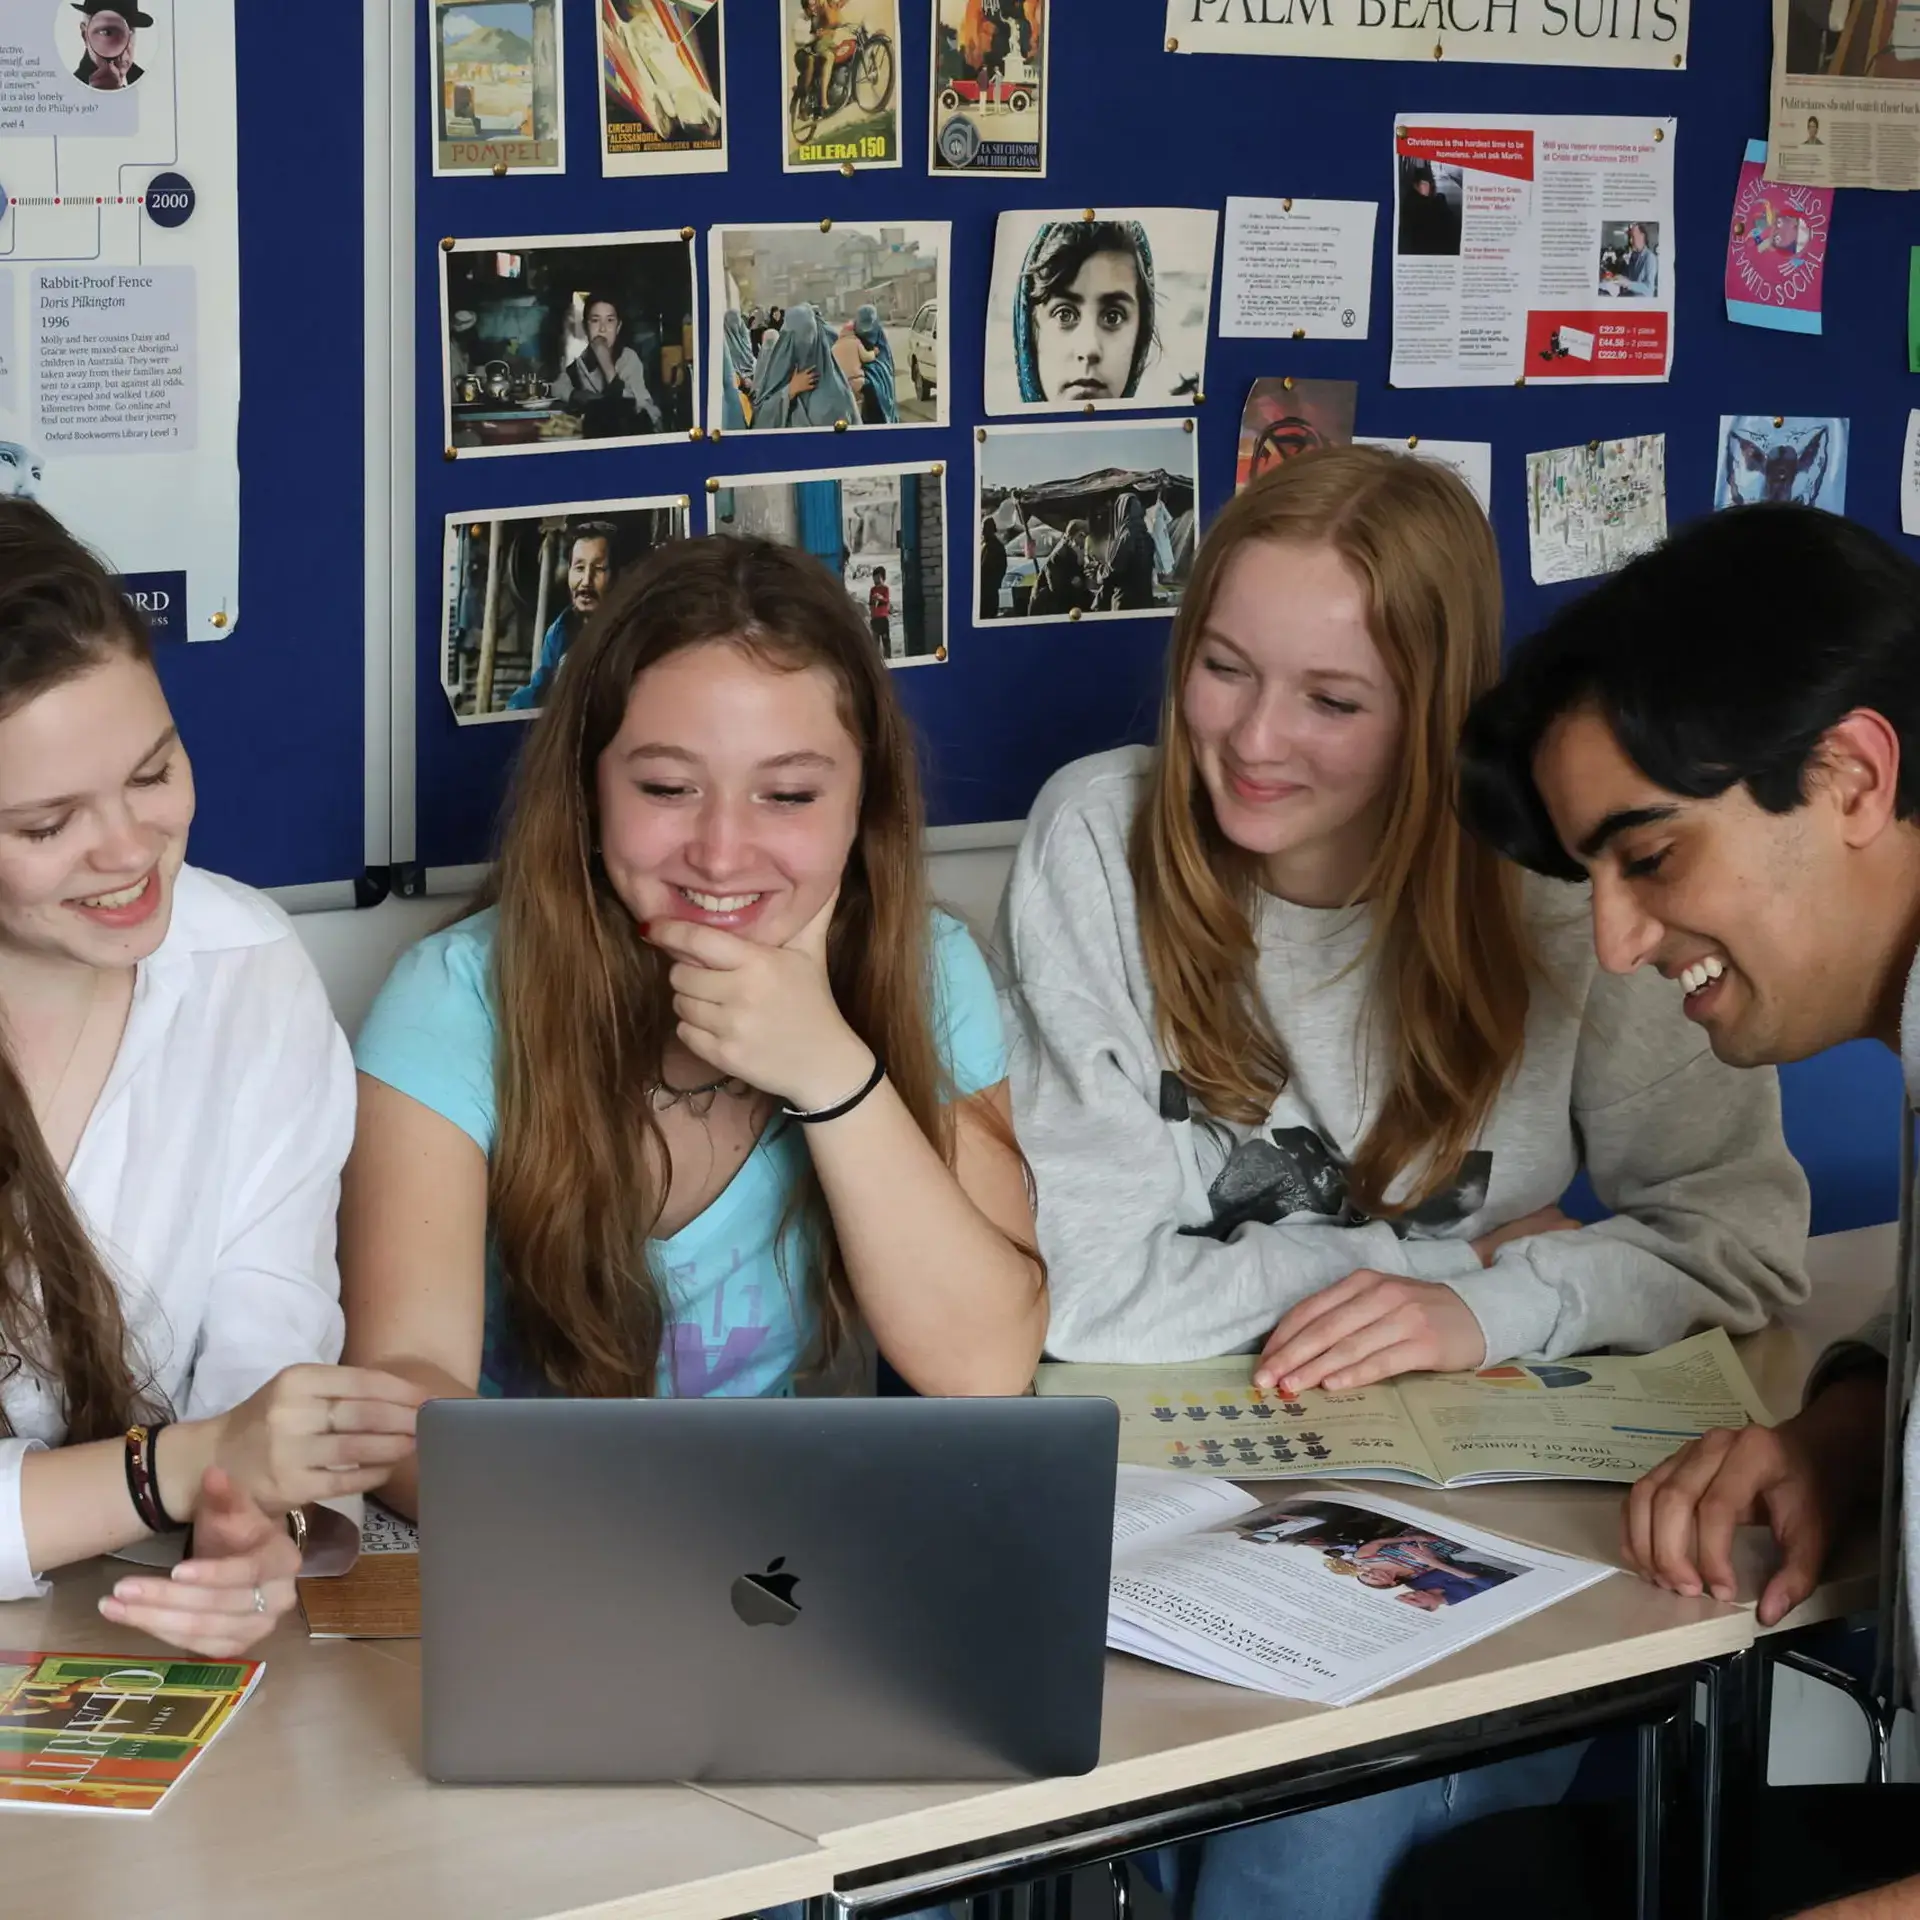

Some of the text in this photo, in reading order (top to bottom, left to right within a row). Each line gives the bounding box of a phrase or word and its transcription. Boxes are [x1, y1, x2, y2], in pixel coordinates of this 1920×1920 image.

[1357, 0, 1518, 33] BEACH
[19, 92, 35, 101] also
[36, 104, 46, 112] do
[1780, 96, 1824, 110] Politicians
[1827, 97, 1854, 112] should
[799, 136, 886, 161] GILERA 150
[1407, 138, 1524, 149] Christmas is the hardest time to be
[1543, 141, 1556, 150] Will
[1557, 142, 1569, 151] you
[1570, 143, 1598, 151] reserve
[1599, 144, 1630, 152] someone
[452, 143, 541, 161] POMPEI
[1436, 150, 1471, 159] homeless.
[1472, 150, 1487, 159] Just
[1488, 151, 1500, 159] ask
[1552, 153, 1571, 161] Crisis
[1572, 154, 1579, 162] at
[1580, 154, 1618, 163] Christmas
[152, 194, 188, 208] 2000
[1732, 177, 1777, 301] CLIMATE JUSTIC
[1775, 186, 1827, 305] SOCIAL JUSTIC
[40, 275, 153, 289] Rabbit-Proof Fence
[40, 295, 125, 310] Doris Pilkington
[42, 317, 70, 328] 1996
[41, 333, 170, 346] Molly and her cousins Daisy and
[69, 347, 88, 355] were
[137, 344, 179, 354] Aboriginal
[40, 358, 75, 367] children
[129, 356, 148, 366] They
[41, 366, 182, 379] taken away from their families and
[41, 381, 58, 390] sent
[60, 381, 69, 389] to
[105, 379, 118, 388] but
[121, 379, 149, 389] against
[151, 378, 161, 386] all
[40, 393, 59, 403] they
[61, 392, 93, 402] escaped
[95, 391, 111, 400] and
[113, 390, 141, 399] walked
[41, 404, 85, 413] kilometres
[115, 402, 126, 411] Go
[128, 401, 153, 410] online
[156, 401, 170, 409] and
[41, 412, 178, 425] find out more about their journey
[45, 432, 72, 441] Oxford
[74, 431, 121, 440] Bookworms
[122, 429, 149, 440] Library
[150, 428, 170, 437] Level
[1544, 1444, 1564, 1452] OF
[1570, 1447, 1612, 1455] THINK
[143, 1707, 176, 1735] SPRING
[10, 1669, 165, 1796] CLARITY
